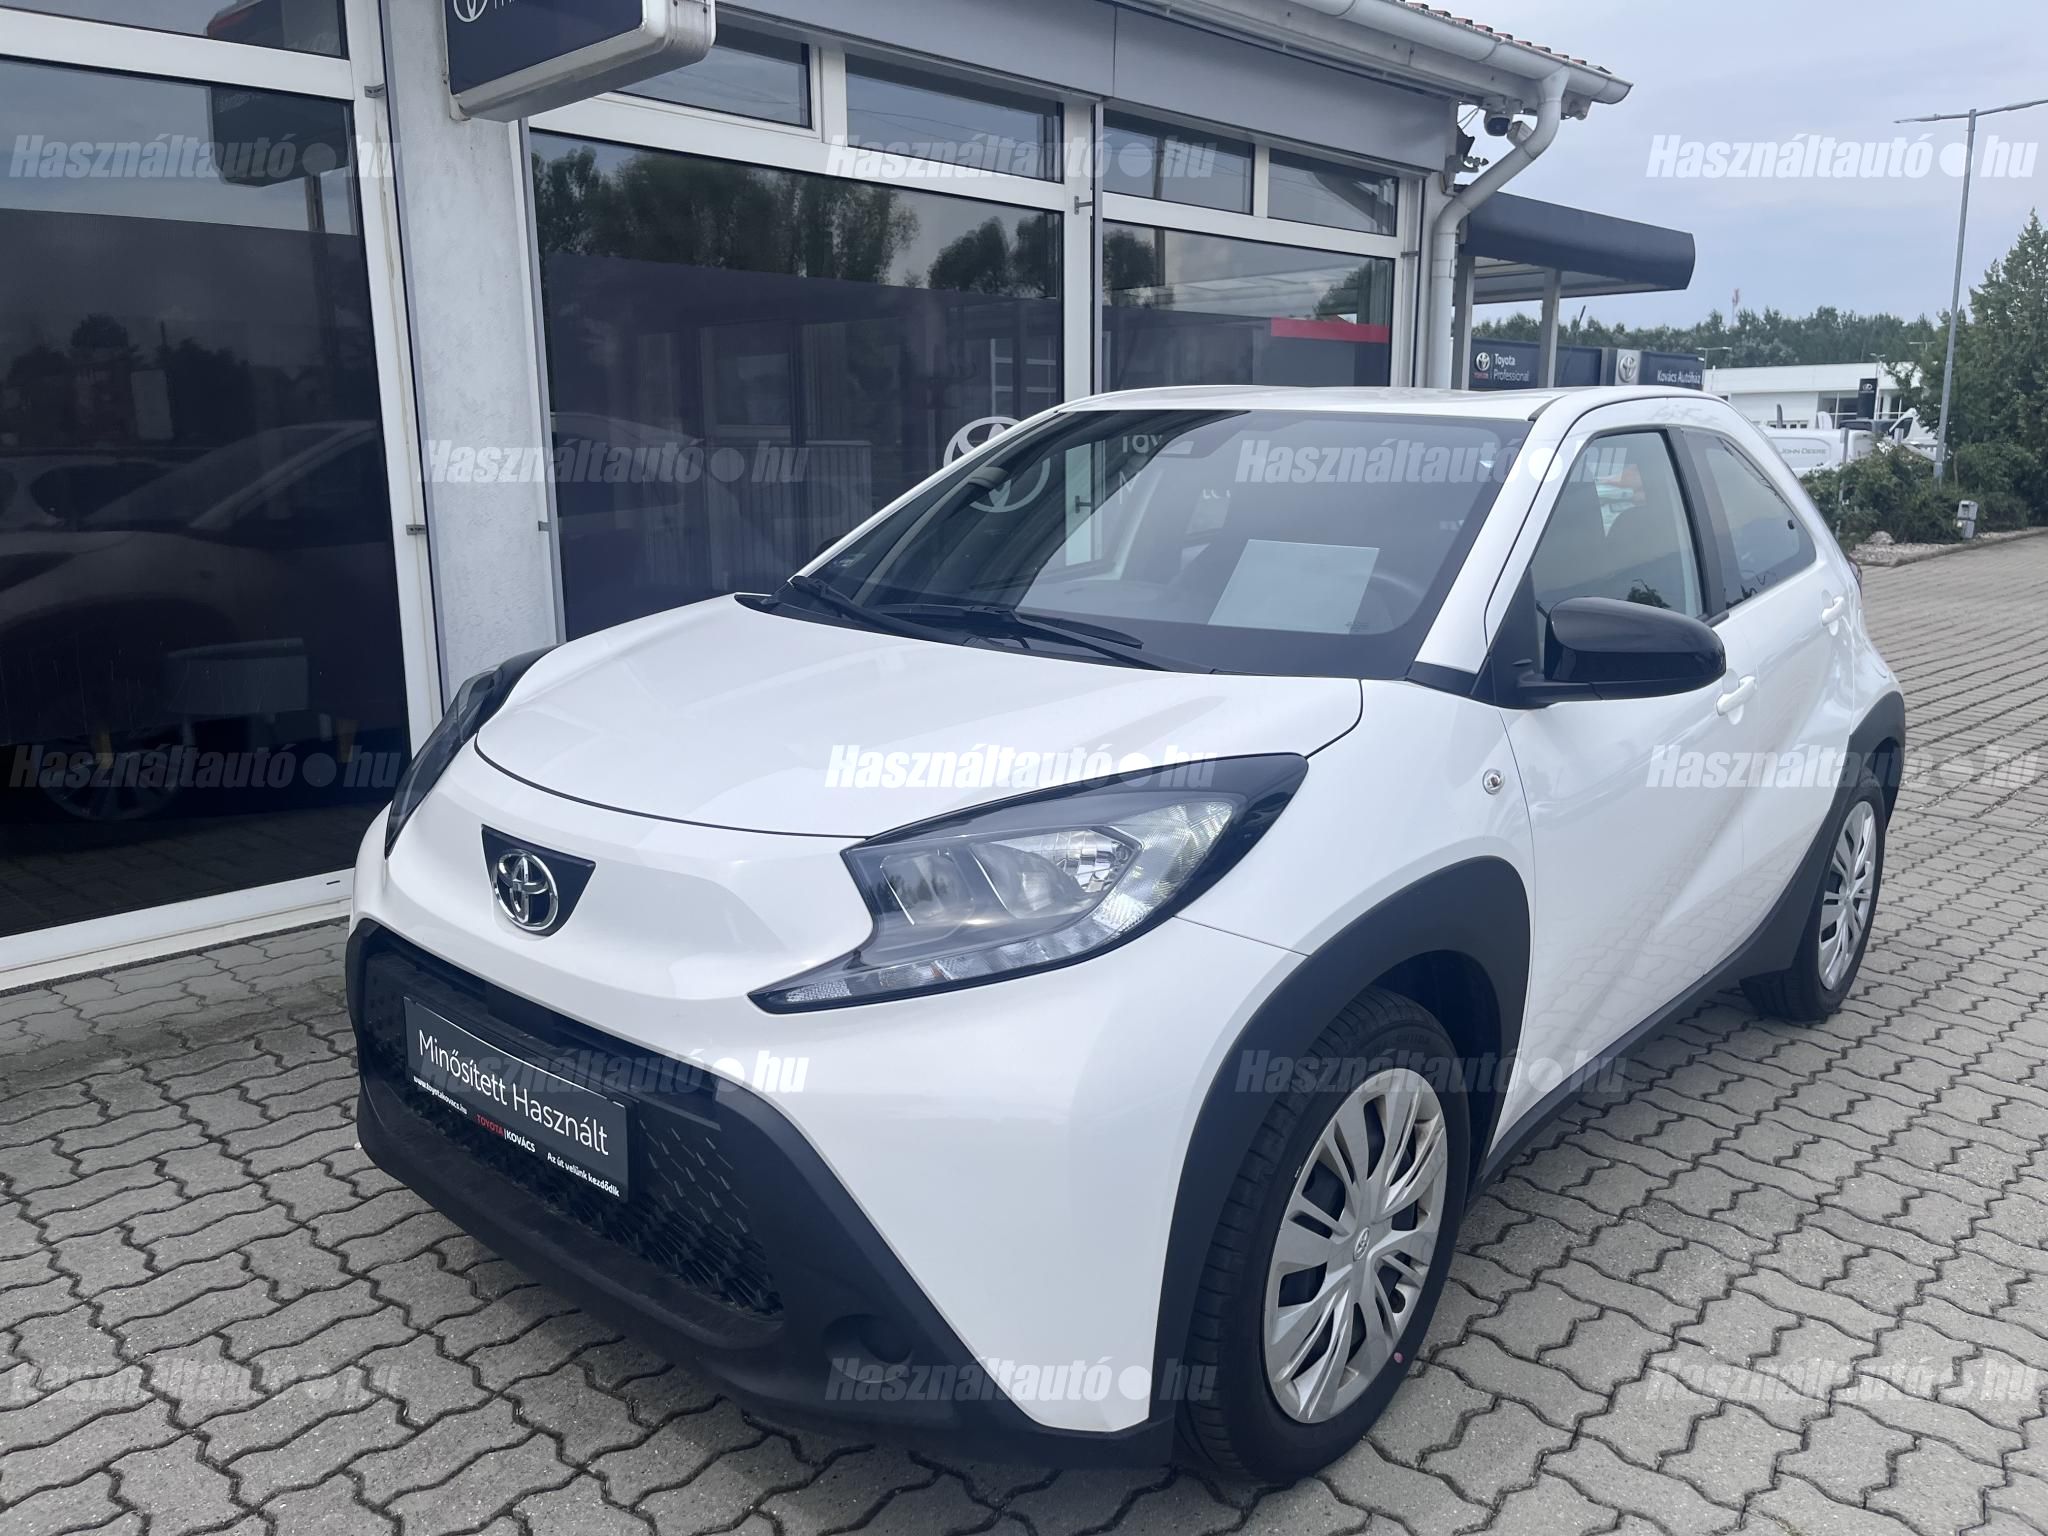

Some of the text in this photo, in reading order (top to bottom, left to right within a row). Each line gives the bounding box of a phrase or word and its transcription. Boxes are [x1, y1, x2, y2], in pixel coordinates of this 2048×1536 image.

[1493, 369, 1530, 382] Professional
[1494, 353, 1516, 368] Toyota
[418, 1029, 609, 1156] Minősített Használt
[547, 1152, 620, 1197] Az út velünk kezdődik
